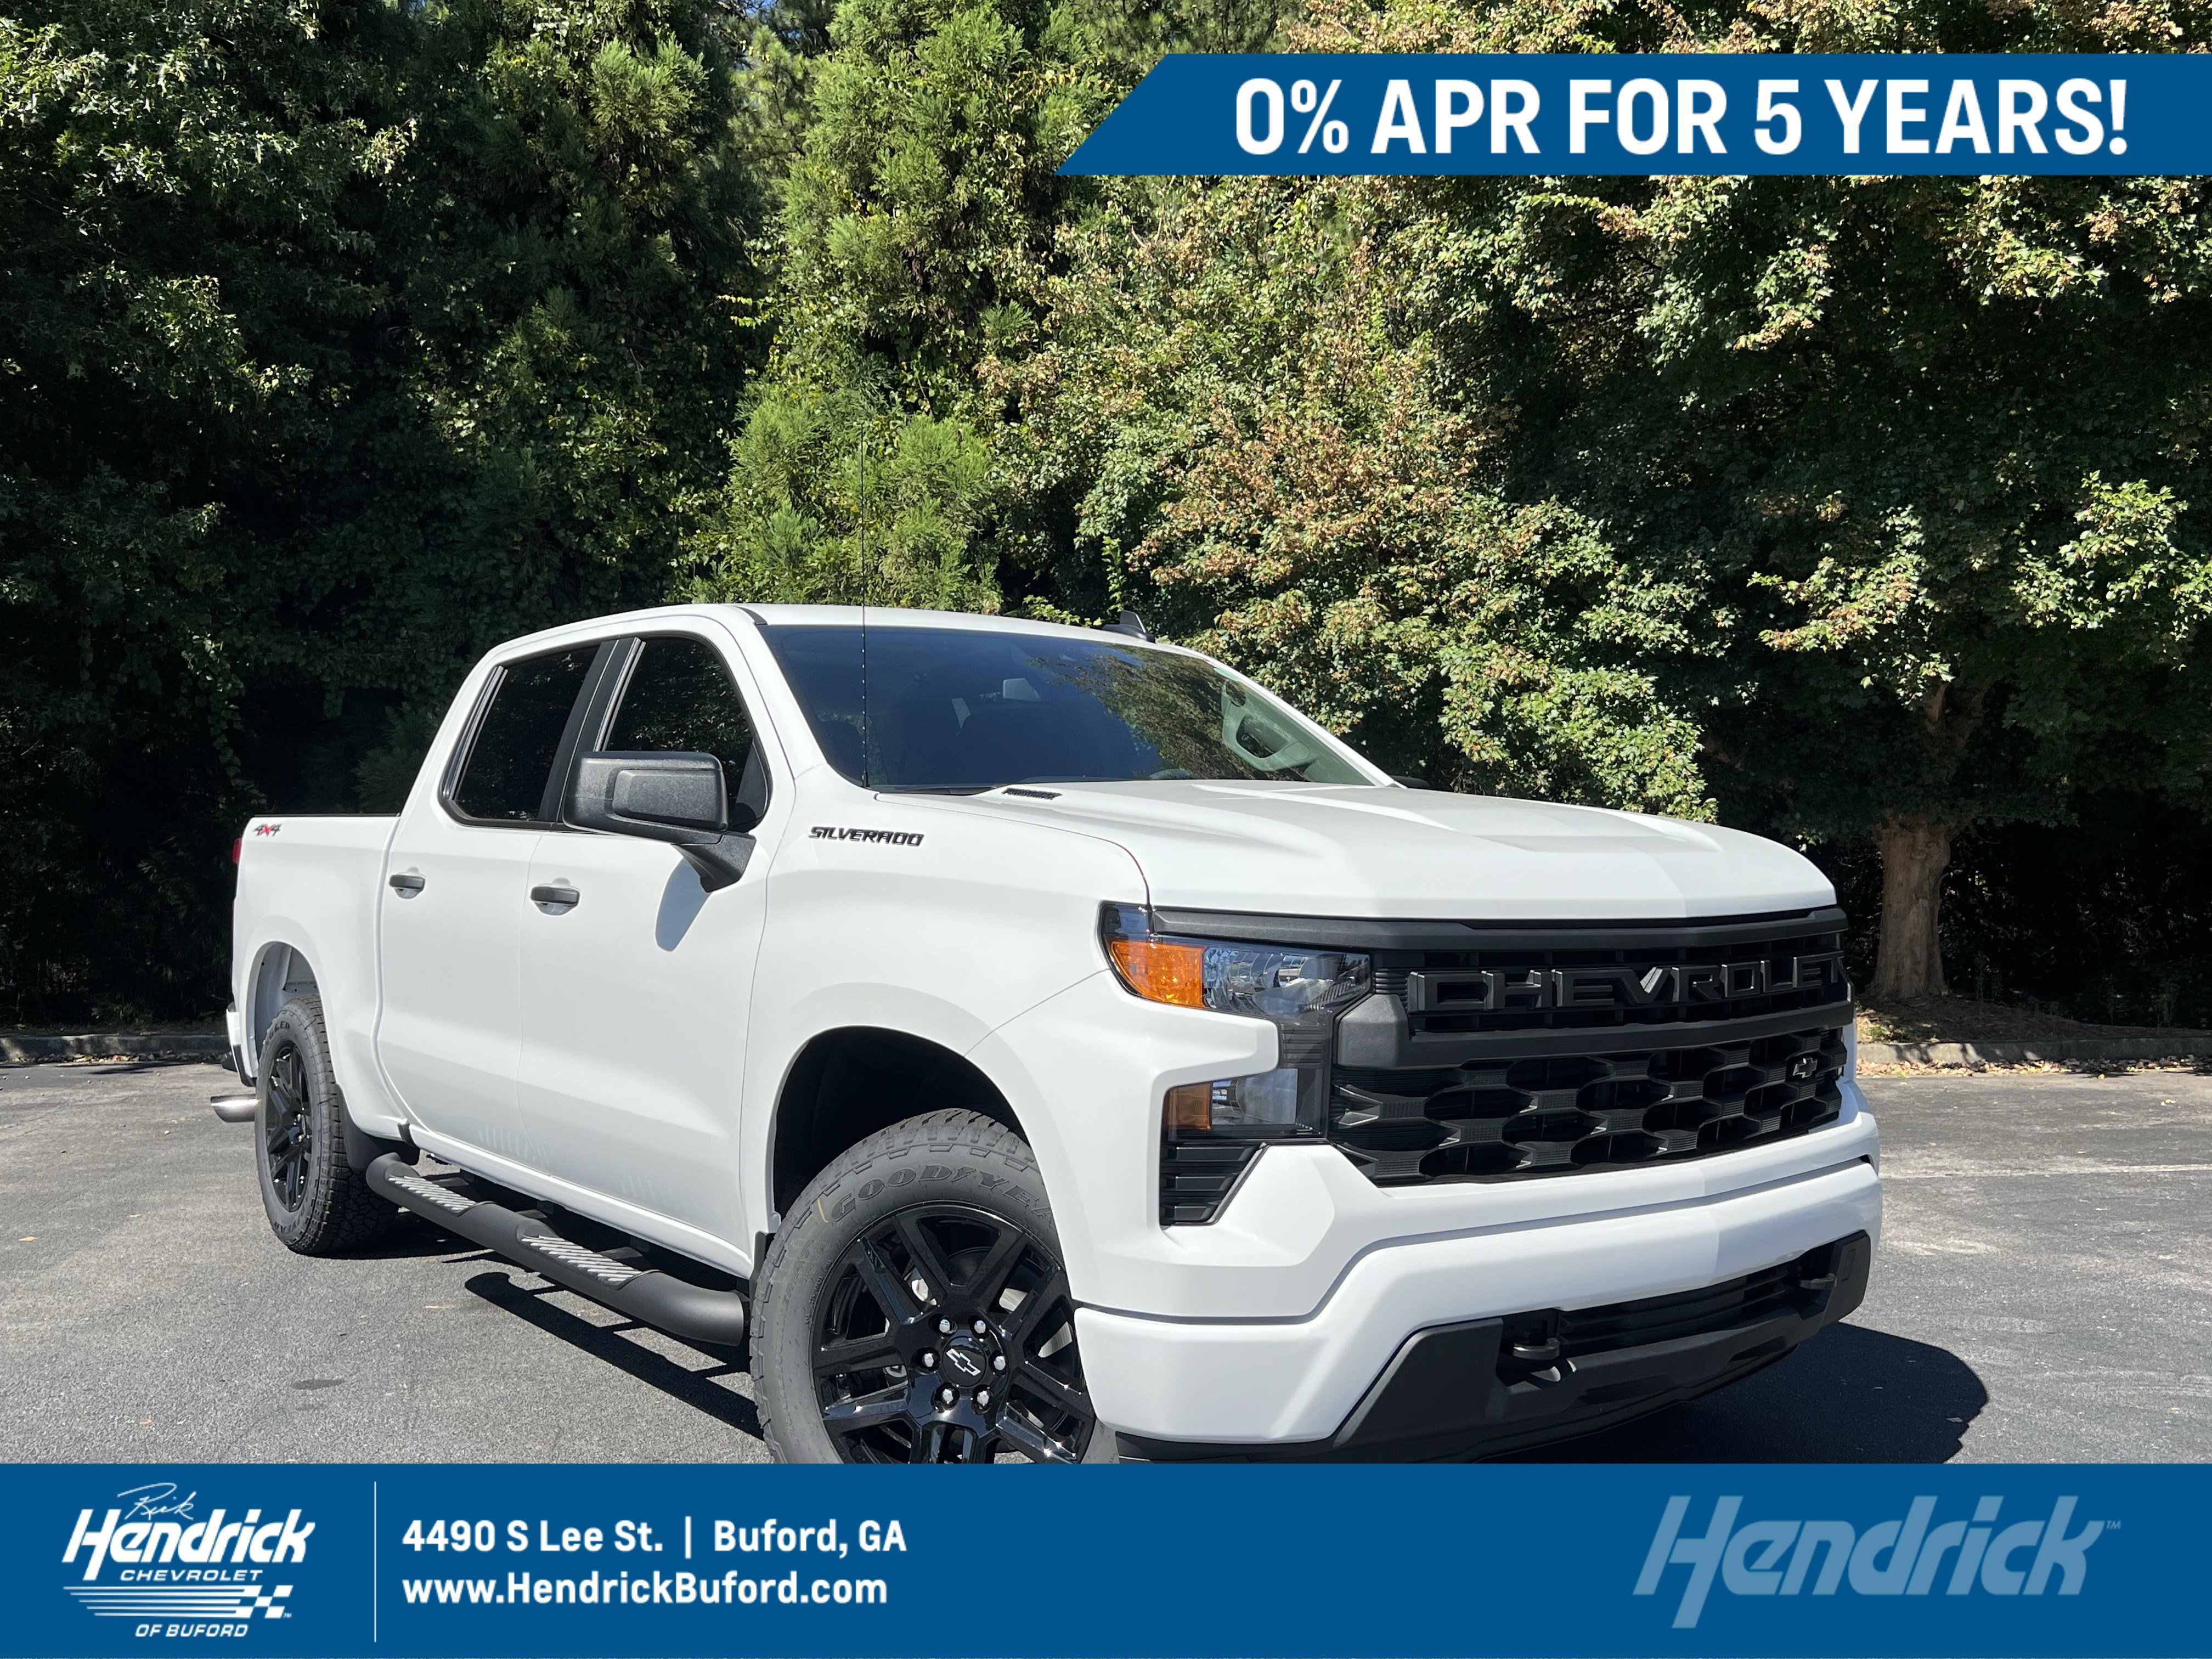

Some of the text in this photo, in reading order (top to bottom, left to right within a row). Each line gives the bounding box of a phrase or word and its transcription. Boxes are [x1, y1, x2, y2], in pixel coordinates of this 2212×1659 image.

[809, 826, 924, 847] SILVERADO
[1407, 951, 1844, 1013] CHEVROLET
[832, 1165, 1054, 1228] GOODYEA
